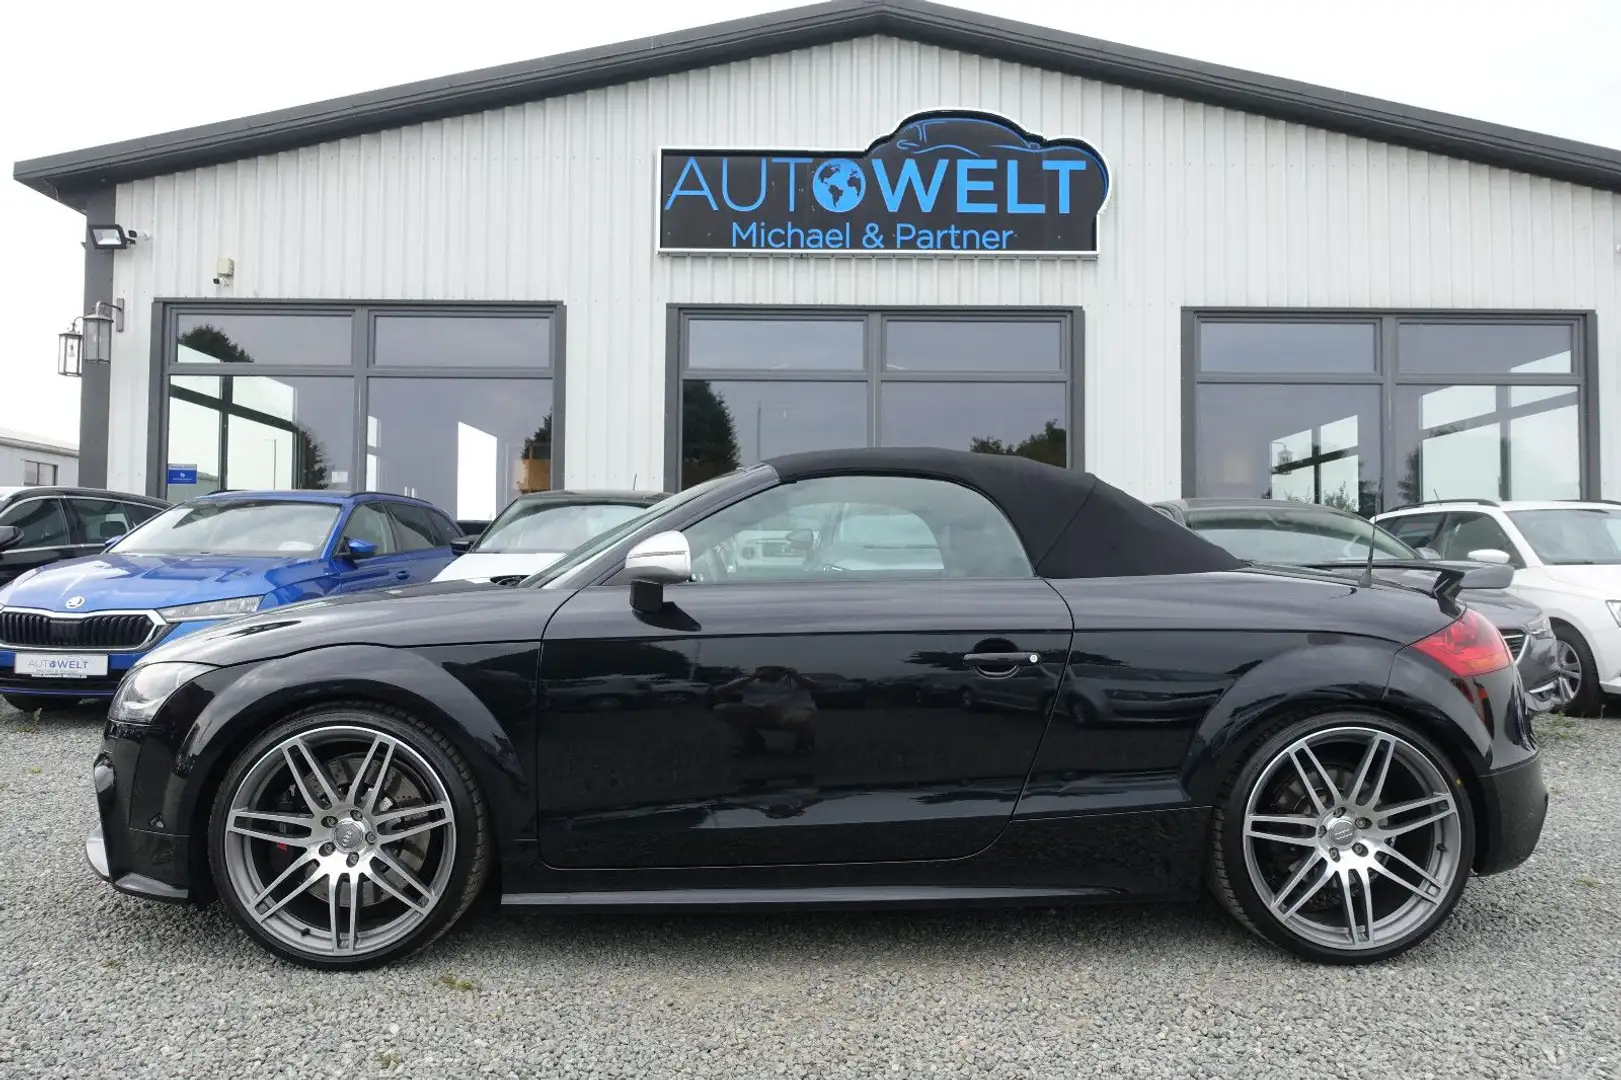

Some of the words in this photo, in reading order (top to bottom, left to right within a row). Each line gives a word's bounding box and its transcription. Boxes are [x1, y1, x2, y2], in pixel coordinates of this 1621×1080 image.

[665, 156, 1087, 214] AUTOWELT
[731, 221, 850, 249] Michael
[861, 222, 885, 249] &
[896, 223, 1014, 249] Partner
